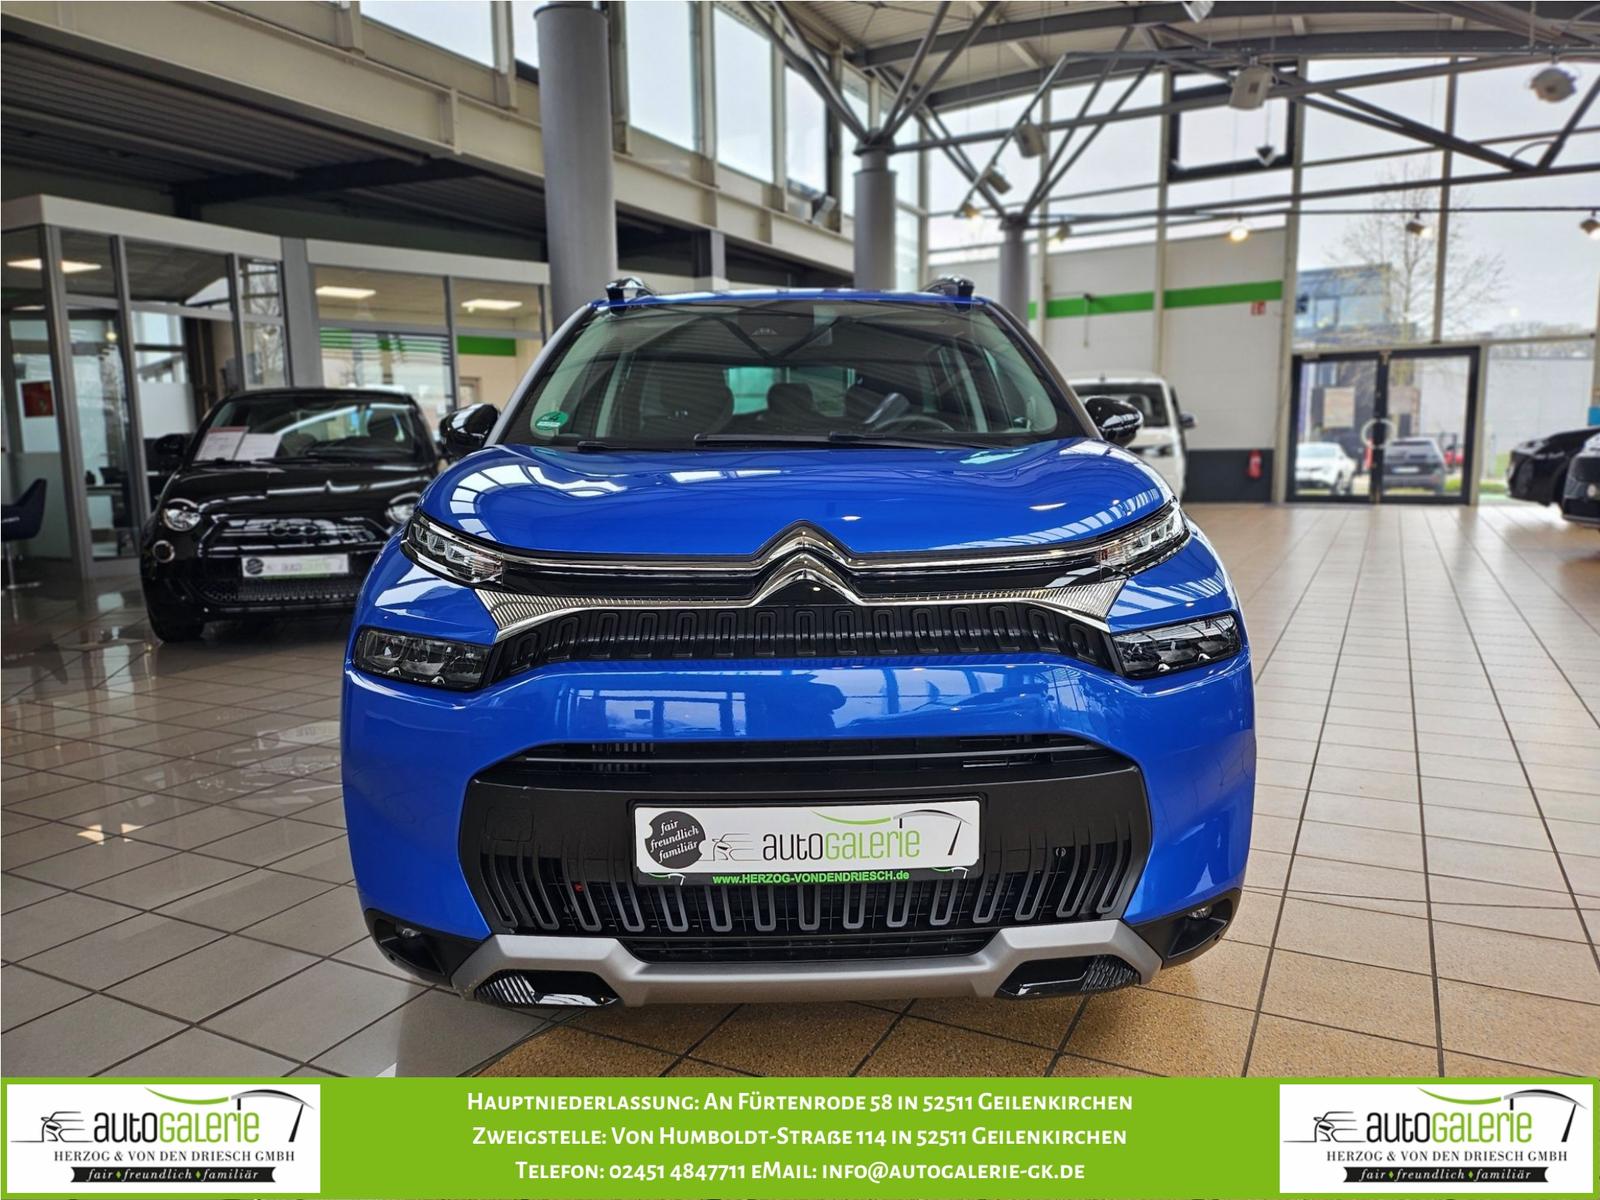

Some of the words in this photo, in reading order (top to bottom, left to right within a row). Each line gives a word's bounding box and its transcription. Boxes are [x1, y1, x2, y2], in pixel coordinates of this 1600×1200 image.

[660, 819, 679, 837] fair
[650, 825, 700, 854] freundlich
[658, 840, 698, 864] familiär
[712, 871, 910, 885] www.HERZOG-VONDENDRIESCH.de
